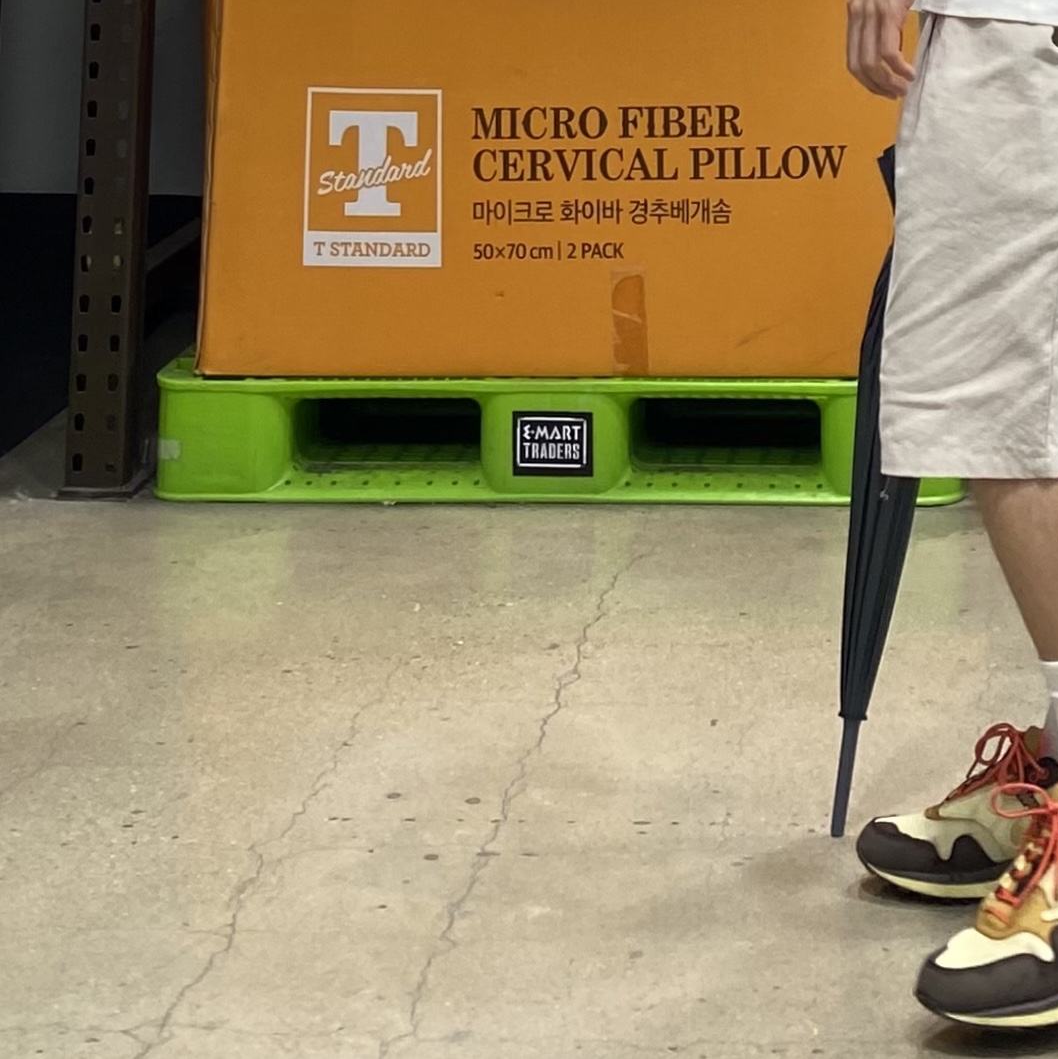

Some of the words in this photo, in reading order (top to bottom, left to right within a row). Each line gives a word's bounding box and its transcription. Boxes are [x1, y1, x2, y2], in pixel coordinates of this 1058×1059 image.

[471, 106, 608, 141] MICRO
[618, 104, 744, 139] FIBER
[317, 148, 432, 197] Standard
[329, 110, 418, 217] T
[472, 147, 680, 183] CERVICAL
[689, 145, 848, 181] PILLOW
[473, 199, 554, 225] 마이크로
[560, 198, 624, 225] 화이바
[630, 198, 732, 225] 경추베개솜
[313, 242, 327, 257] T
[330, 242, 431, 258] STANDARD
[566, 243, 577, 259] 2
[581, 243, 625, 260] PACK
[523, 442, 580, 460] TRADERS
